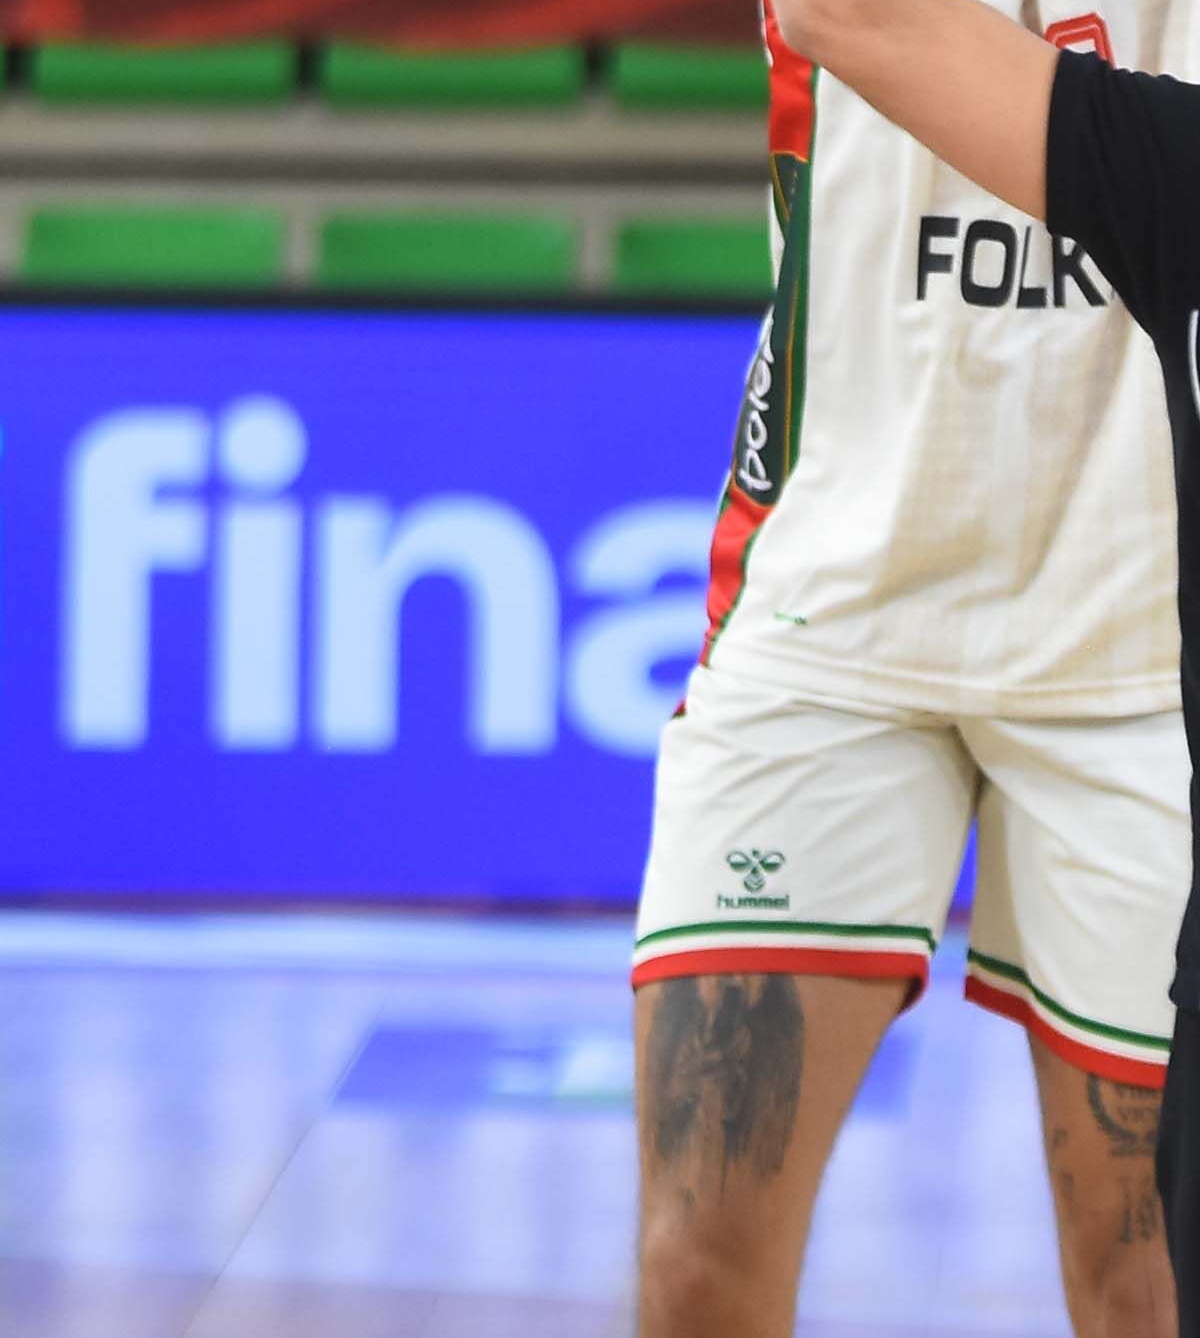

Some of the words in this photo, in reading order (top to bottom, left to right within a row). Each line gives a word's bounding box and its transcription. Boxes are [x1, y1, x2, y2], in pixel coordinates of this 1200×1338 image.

[916, 215, 1110, 309] FOLK
[738, 303, 776, 491] pole
[717, 893, 790, 911] hummel
